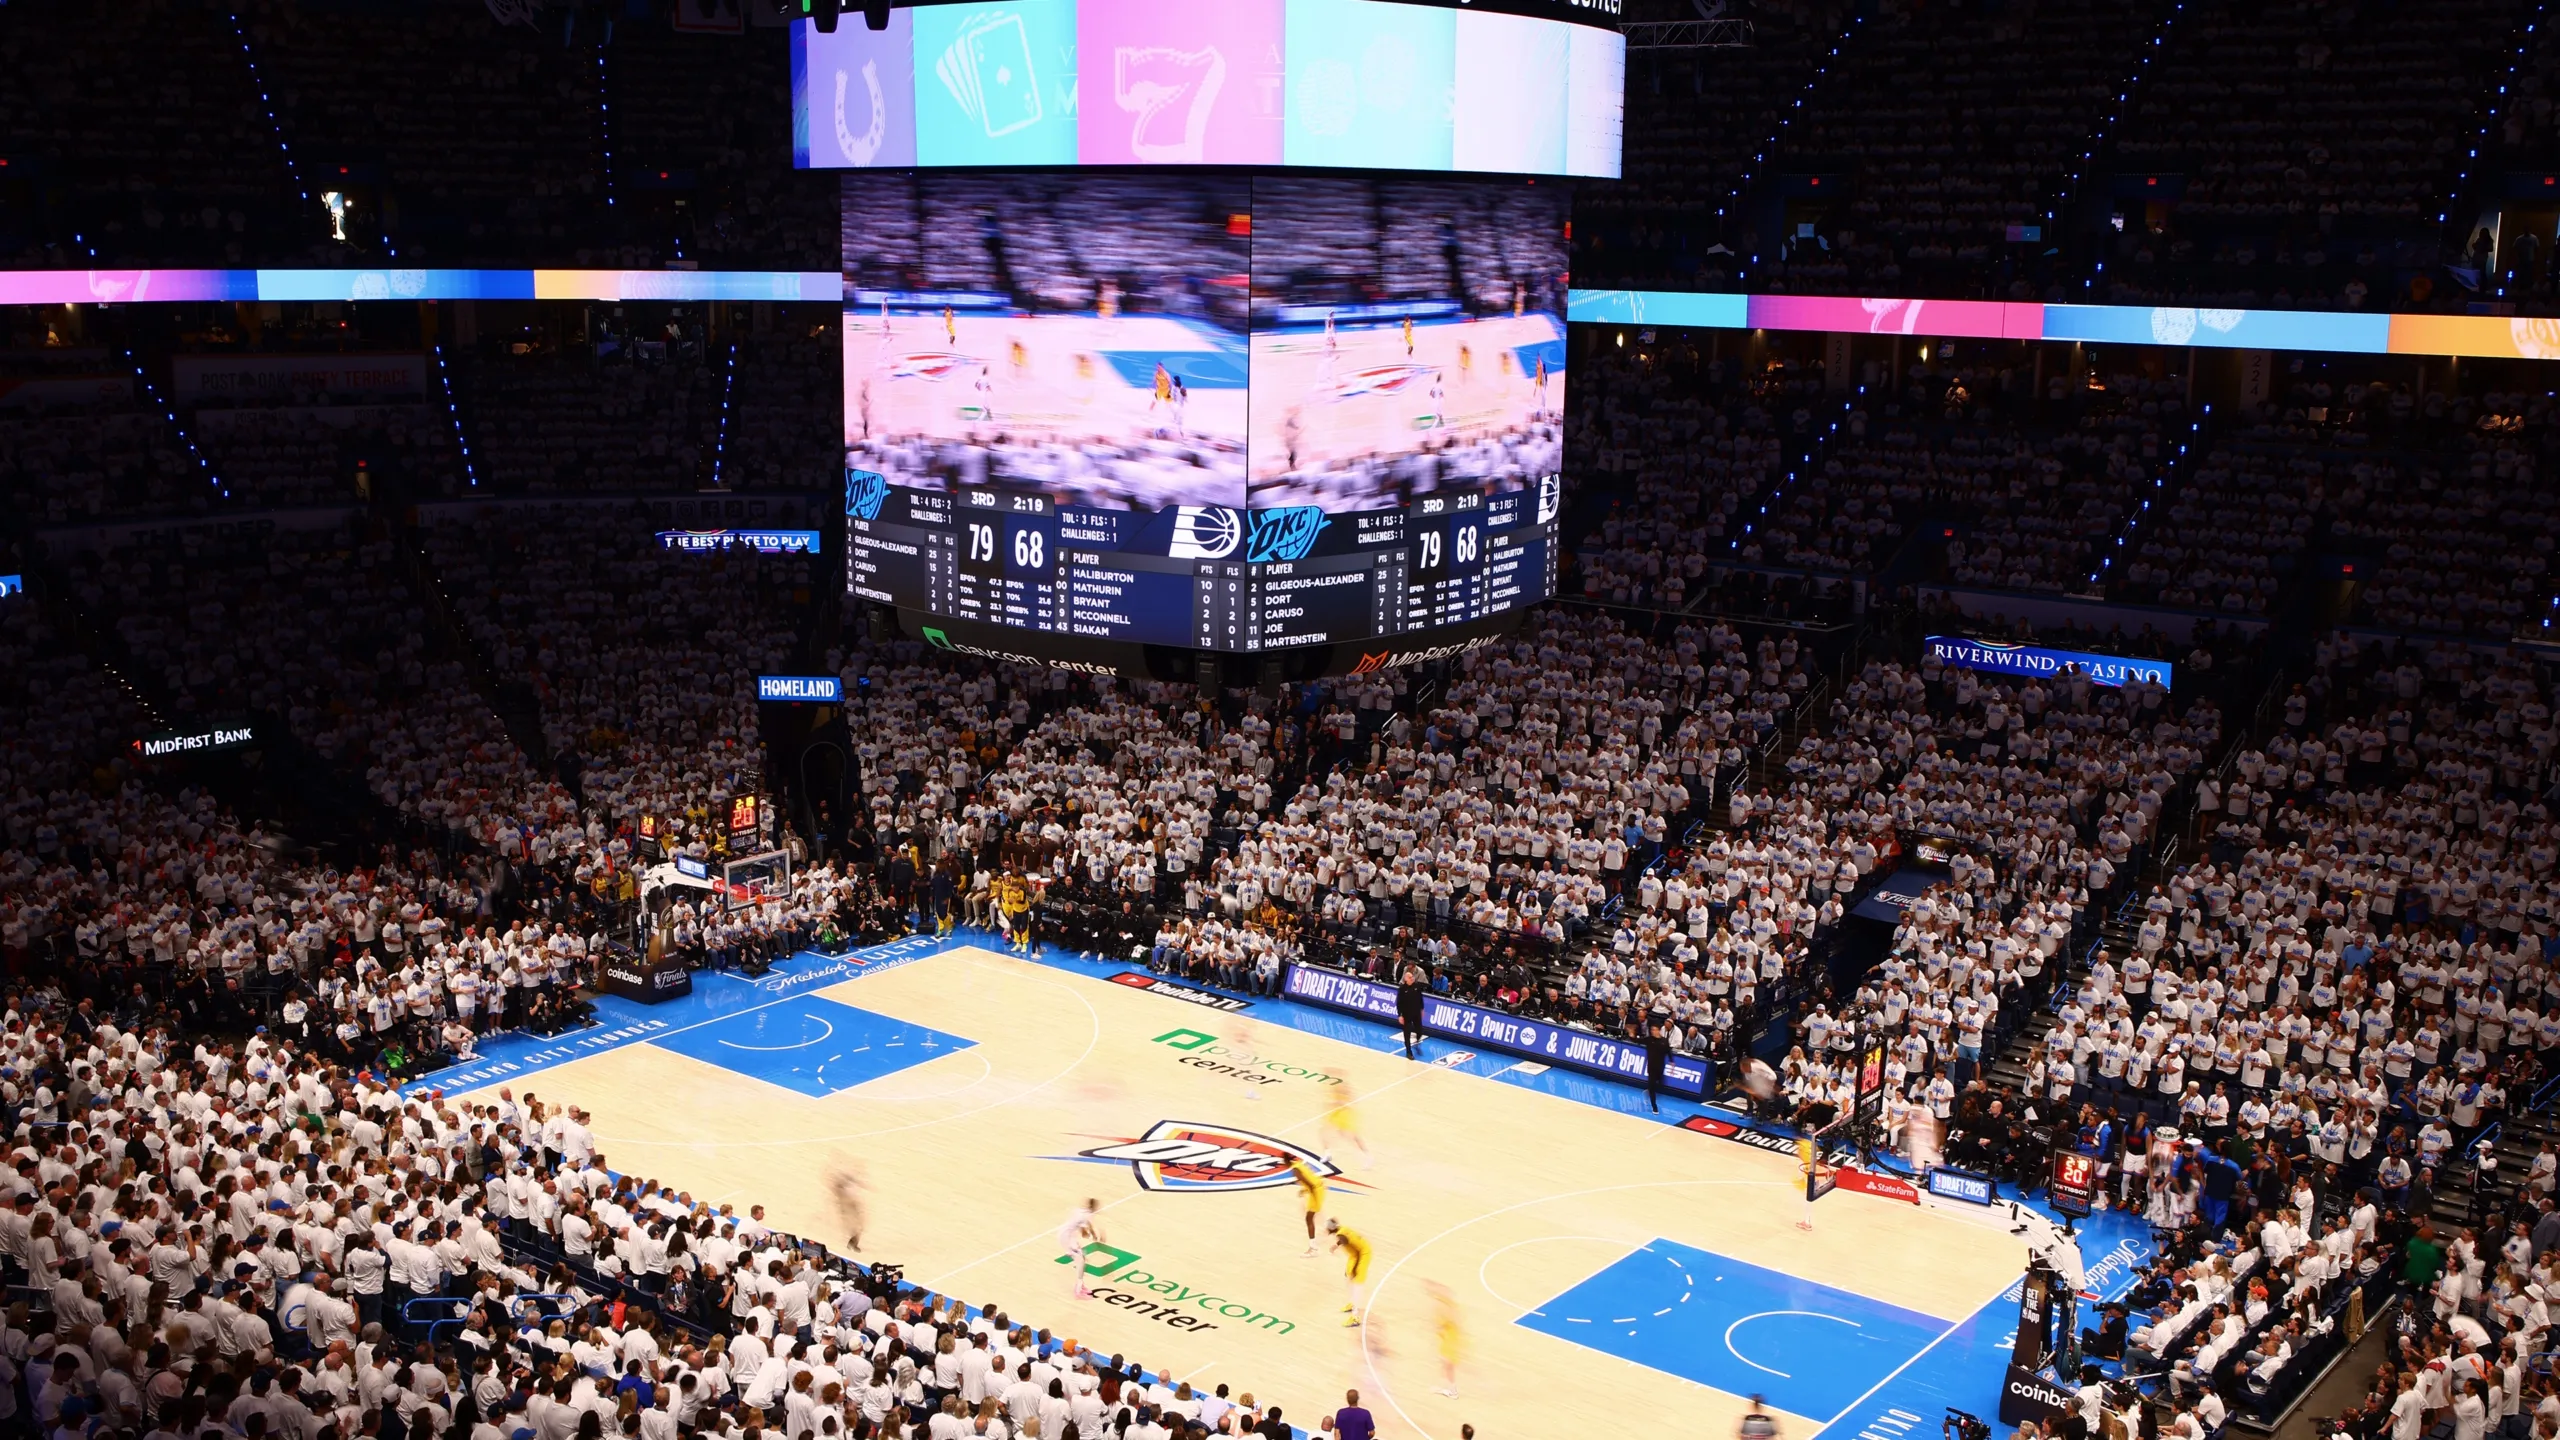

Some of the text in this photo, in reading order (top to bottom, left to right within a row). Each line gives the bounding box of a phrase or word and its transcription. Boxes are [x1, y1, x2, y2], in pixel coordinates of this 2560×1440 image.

[344, 369, 408, 387] TERRACE
[971, 492, 995, 506] 3RD
[1423, 498, 1444, 513] 3RD
[1082, 515, 1086, 524] 3
[1091, 515, 1107, 526] FLS:
[1112, 517, 1116, 527] 1
[1375, 517, 1380, 526] 4
[1399, 515, 1403, 524] 2
[692, 536, 720, 547] BEST
[763, 536, 778, 546] TO
[782, 537, 810, 547] PLAY
[855, 535, 917, 556] GILGEOUS-ALEXANDER
[969, 524, 993, 562] 79
[1062, 527, 1117, 543] CHALLENGES: 1
[1358, 530, 1403, 544] CHALLENGES: 1
[1457, 525, 1477, 563] 68
[855, 548, 869, 558] DORT
[1015, 530, 1044, 568] 68
[1420, 530, 1441, 569] 79
[855, 561, 876, 572] CARUSO
[1073, 553, 1099, 565] PLAYER
[1201, 565, 1213, 574] PTS
[1227, 567, 1239, 576] FLS
[1267, 563, 1293, 575] PLAYER
[855, 574, 865, 583] JOE
[1059, 567, 1236, 592] 0 HALIBURTON 10 0
[1251, 568, 1402, 592] 2 GILGEOUS-ALEXANDER 25 2
[856, 586, 892, 602] HARTENSTEIN
[1056, 581, 1235, 606] 00 MATHURIN 0 1
[1251, 582, 1402, 606] 5 DORT 15 2
[1059, 595, 1236, 620] 3 BRYANT 2 2
[1250, 596, 1401, 620] 9 CARUSO 7 2
[1059, 609, 1236, 635] 9 MCCONNELL 9 0
[1249, 609, 1401, 635] 11 JOE 2 0
[1057, 622, 1234, 648] 43 SIAKAM 13 1
[1247, 622, 1400, 649] 55 HARTENSTEIN 9 1
[954, 643, 1118, 676] paycom center
[1934, 644, 2056, 672] RIVERWIND
[761, 680, 834, 697] HOMELAND
[863, 934, 952, 960] ULTRA
[608, 968, 642, 985] coinbase
[660, 967, 687, 989] Finals
[1147, 981, 1246, 1010] YouTube TV
[1301, 970, 1369, 1009] DRAFT 2025
[1371, 988, 1390, 1001] Presented
[524, 1046, 574, 1064] CITY
[577, 1019, 669, 1048] THUNDER
[1431, 1004, 1702, 1084] JUNE 25 8PM ET abc & JUNE 26 8PM ESPN
[1178, 1056, 1283, 1085] center
[1200, 1044, 1343, 1086] paycom
[1092, 1138, 1283, 1172] OKC
[1941, 1176, 1965, 1192] DRAFT
[1966, 1180, 1986, 1198] 2025
[2064, 1167, 2082, 1184] 20
[2064, 1186, 2088, 1196] TISSOT
[1114, 1269, 1295, 1335] paycom
[2026, 1298, 2038, 1310] THE
[2027, 1288, 2039, 1300] GET
[1088, 1287, 1218, 1332] center
[2028, 1310, 2040, 1324] App
